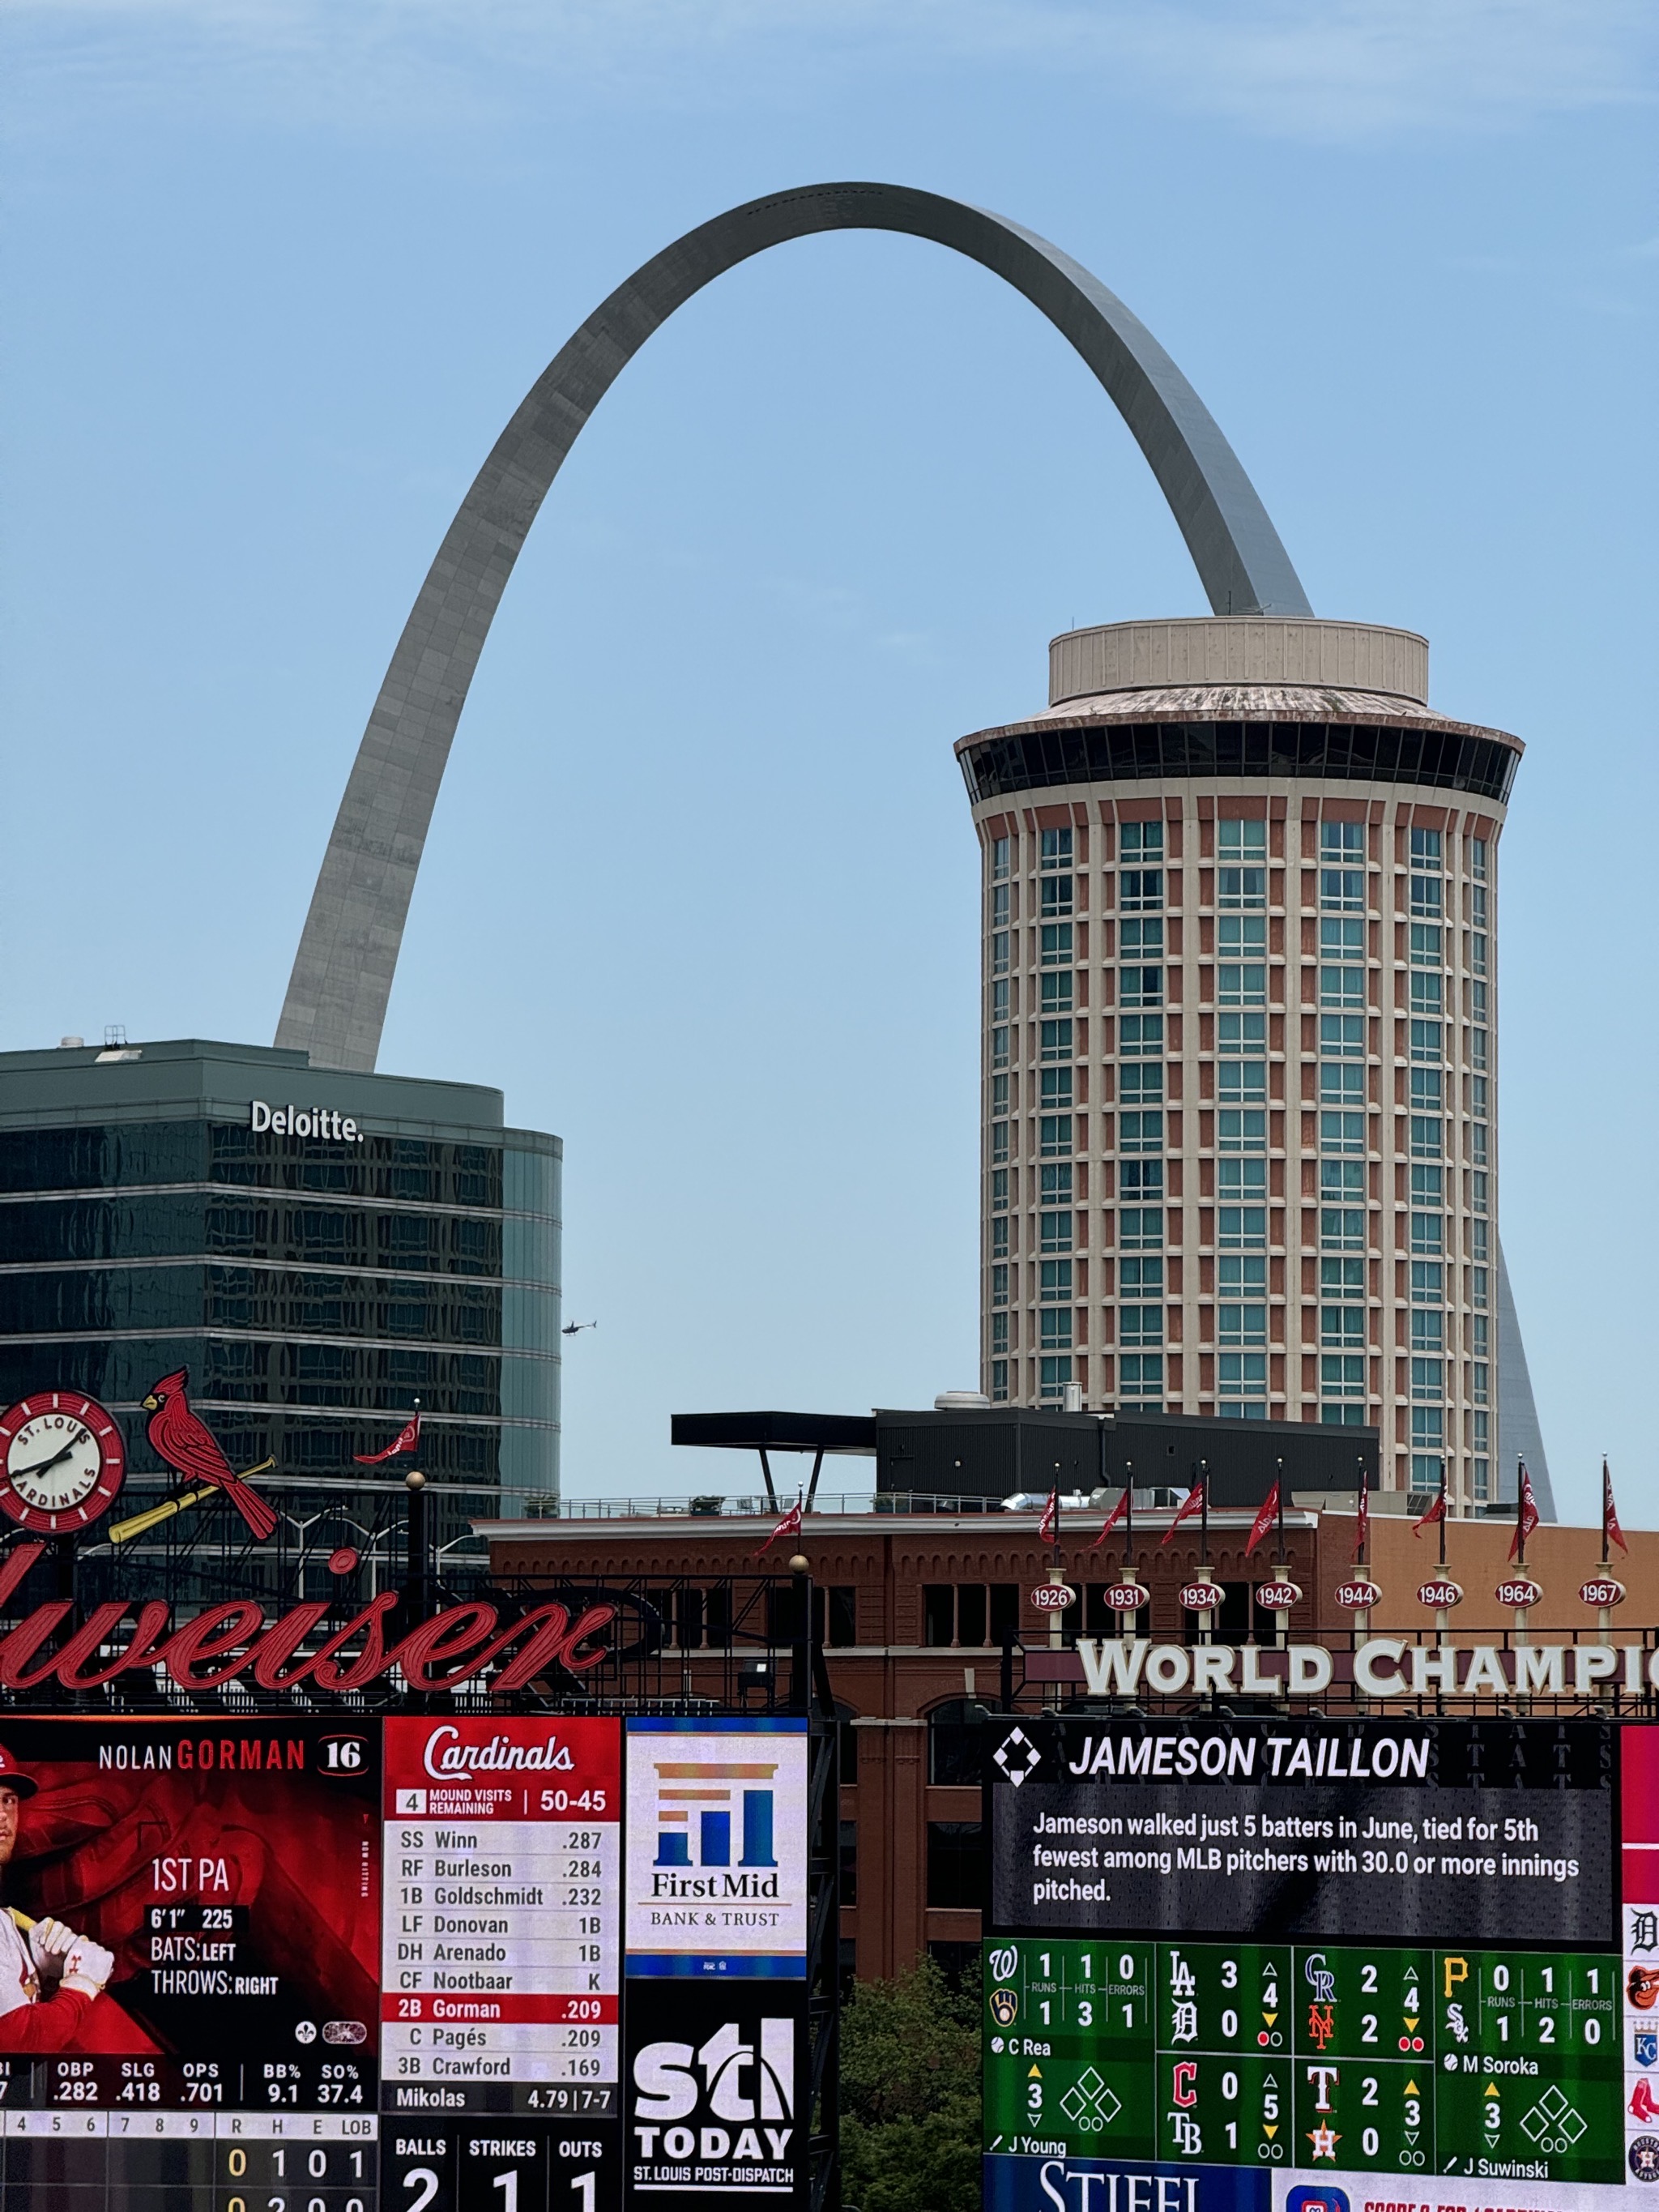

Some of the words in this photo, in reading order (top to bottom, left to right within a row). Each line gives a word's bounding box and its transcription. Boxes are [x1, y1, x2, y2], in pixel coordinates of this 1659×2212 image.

[251, 1100, 364, 1142] Deloitte.
[18, 1425, 41, 1445] ST.
[43, 1417, 91, 1445] LOUS
[12, 1468, 96, 1508] ARDINALS
[1034, 1590, 1068, 1605] 1926
[1109, 1589, 1139, 1605] 1931
[1183, 1588, 1217, 1604] 1934
[1260, 1587, 1293, 1603] 1942
[1338, 1586, 1374, 1603] 1944
[1420, 1586, 1455, 1603] 1946
[1498, 1585, 1535, 1602] 1964
[1582, 1584, 1617, 1602] 1967
[1076, 1638, 1333, 1696] WORLD
[1353, 1637, 1659, 1697] CHAMPI
[99, 1745, 172, 1770] NOLAN
[177, 1740, 305, 1770] GORMAN
[326, 1741, 361, 1769] 16
[424, 1725, 575, 1781] Cardinals
[1068, 1736, 1256, 1776] JAMESON
[1267, 1737, 1431, 1778] TAILLON
[406, 1793, 418, 1812] 4
[429, 1789, 472, 1802] MOUND
[475, 1789, 512, 1802] VISITS
[540, 1790, 607, 1811] 50-45
[429, 1802, 494, 1815] REMAINING
[1033, 1812, 1123, 1834] Jameson
[1127, 1813, 1197, 1836] walked
[1200, 1815, 1239, 1841] just
[1243, 1816, 1256, 1837] 5
[1261, 1814, 1333, 1838] batters
[1339, 1817, 1357, 1838] in
[1362, 1817, 1418, 1844] June,
[1422, 1817, 1462, 1840] tied
[1467, 1817, 1499, 1841] for
[1503, 1818, 1538, 1842] 5th
[401, 1830, 424, 1848] SS
[434, 1831, 478, 1848] Winn
[562, 1832, 602, 1849] .287
[401, 1859, 424, 1877] RF
[434, 1859, 512, 1877] Burleson
[562, 1860, 602, 1878] .284
[1033, 1844, 1100, 1868] fewest
[1103, 1850, 1172, 1875] among
[1176, 1848, 1222, 1870] MLB
[1226, 1848, 1308, 1876] pitchers
[1313, 1850, 1357, 1873] with
[1362, 1851, 1409, 1874] 30.0
[1413, 1856, 1435, 1874] or
[1440, 1858, 1497, 1876] more
[1501, 1852, 1580, 1882] innings
[151, 1858, 193, 1891] 1ST
[198, 1858, 229, 1892] PA
[651, 1873, 719, 1898] First
[722, 1873, 779, 1898] Mid
[401, 1887, 423, 1904] 1B
[434, 1886, 544, 1905] Goldschmidt
[562, 1888, 602, 1906] .232
[1033, 1879, 1111, 1905] pitched.
[202, 1909, 232, 1929] 225
[402, 1915, 423, 1932] LF
[434, 1915, 509, 1933] Donovan
[578, 1917, 601, 1934] 1B
[651, 1912, 700, 1926] BANK
[705, 1913, 717, 1926] &
[722, 1913, 779, 1926] TRUST
[398, 1943, 423, 1961] DH
[433, 1943, 506, 1962] Arenado
[578, 1945, 601, 1962] 1B
[1120, 1954, 1134, 1979] 0
[1221, 1960, 1237, 1989] 3
[399, 1971, 422, 1988] CF
[433, 1971, 513, 1989] Nootbaar
[588, 1973, 600, 1991] K
[1031, 1982, 1057, 1994] RUNS
[1074, 1983, 1096, 1995] HITS
[1108, 1984, 1145, 1996] ERRORS
[1361, 1965, 1378, 1993] 2
[1494, 1964, 1509, 1992] 0
[1542, 1966, 1554, 1993] 1
[1587, 1968, 1598, 1994] 1
[1263, 1983, 1278, 2008] 4
[1404, 1987, 1420, 2013] 4
[1487, 1996, 1516, 2008] RUNS
[1534, 1997, 1559, 2009] HITS
[1572, 1999, 1613, 2010] ERRORS
[398, 1999, 422, 2017] 2B
[433, 1999, 501, 2018] Gorman
[561, 2001, 601, 2019] .209
[1078, 2001, 1093, 2026] 3
[1222, 2009, 1238, 2038] 0
[1361, 2014, 1378, 2042] 2
[1497, 2016, 1508, 2042] 1
[1539, 2017, 1555, 2043] 2
[1584, 2018, 1601, 2044] 0
[410, 2027, 422, 2045] C
[433, 2027, 487, 2049] Pagés
[561, 2030, 601, 2047] .209
[1009, 2038, 1020, 2055] C
[1024, 2039, 1051, 2056] Rea
[57, 2062, 94, 2077] OBP
[121, 2063, 156, 2077] SLG
[182, 2064, 219, 2078] OPS
[263, 2064, 301, 2079] BB%
[321, 2065, 359, 2080] SO%
[398, 2057, 420, 2074] 3B
[433, 2056, 511, 2075] Crawford
[561, 2059, 600, 2077] .169
[1463, 2056, 1478, 2073] M
[1482, 2056, 1538, 2075] Soroka
[53, 2082, 98, 2101] .282
[116, 2082, 160, 2102] .418
[180, 2082, 223, 2103] .701
[268, 2083, 298, 2103] 9.1
[317, 2084, 364, 2103] 37.4
[1027, 2084, 1043, 2108] 3
[1222, 2072, 1239, 2100] 0
[1362, 2077, 1379, 2106] 2
[396, 2087, 466, 2107] Mikolas
[527, 2090, 568, 2109] 4.79
[582, 2090, 611, 2109] 7-7
[1265, 2095, 1279, 2120] 5
[1405, 2099, 1421, 2127] 3
[1484, 2103, 1501, 2129] 3
[232, 2119, 242, 2134] R
[272, 2119, 284, 2134] H
[313, 2120, 322, 2135] E
[342, 2120, 372, 2136] LOB
[396, 2139, 446, 2155] BALLS
[469, 2140, 536, 2157] STRIKES
[559, 2141, 603, 2158] OUTS
[634, 2126, 794, 2160] TODAY
[1009, 2137, 1018, 2154] J
[1021, 2137, 1067, 2159] Young
[1362, 2128, 1380, 2156] 0
[228, 2148, 246, 2177] 0
[272, 2149, 285, 2178] 1
[308, 2149, 326, 2178] 0
[349, 2150, 363, 2179] 1
[1464, 2157, 1473, 2175] J
[1478, 2159, 1549, 2179] Suwinski
[633, 2166, 652, 2181] ST.
[654, 2167, 691, 2182] LOUIS
[695, 2167, 794, 2184] POST-DISPATCH
